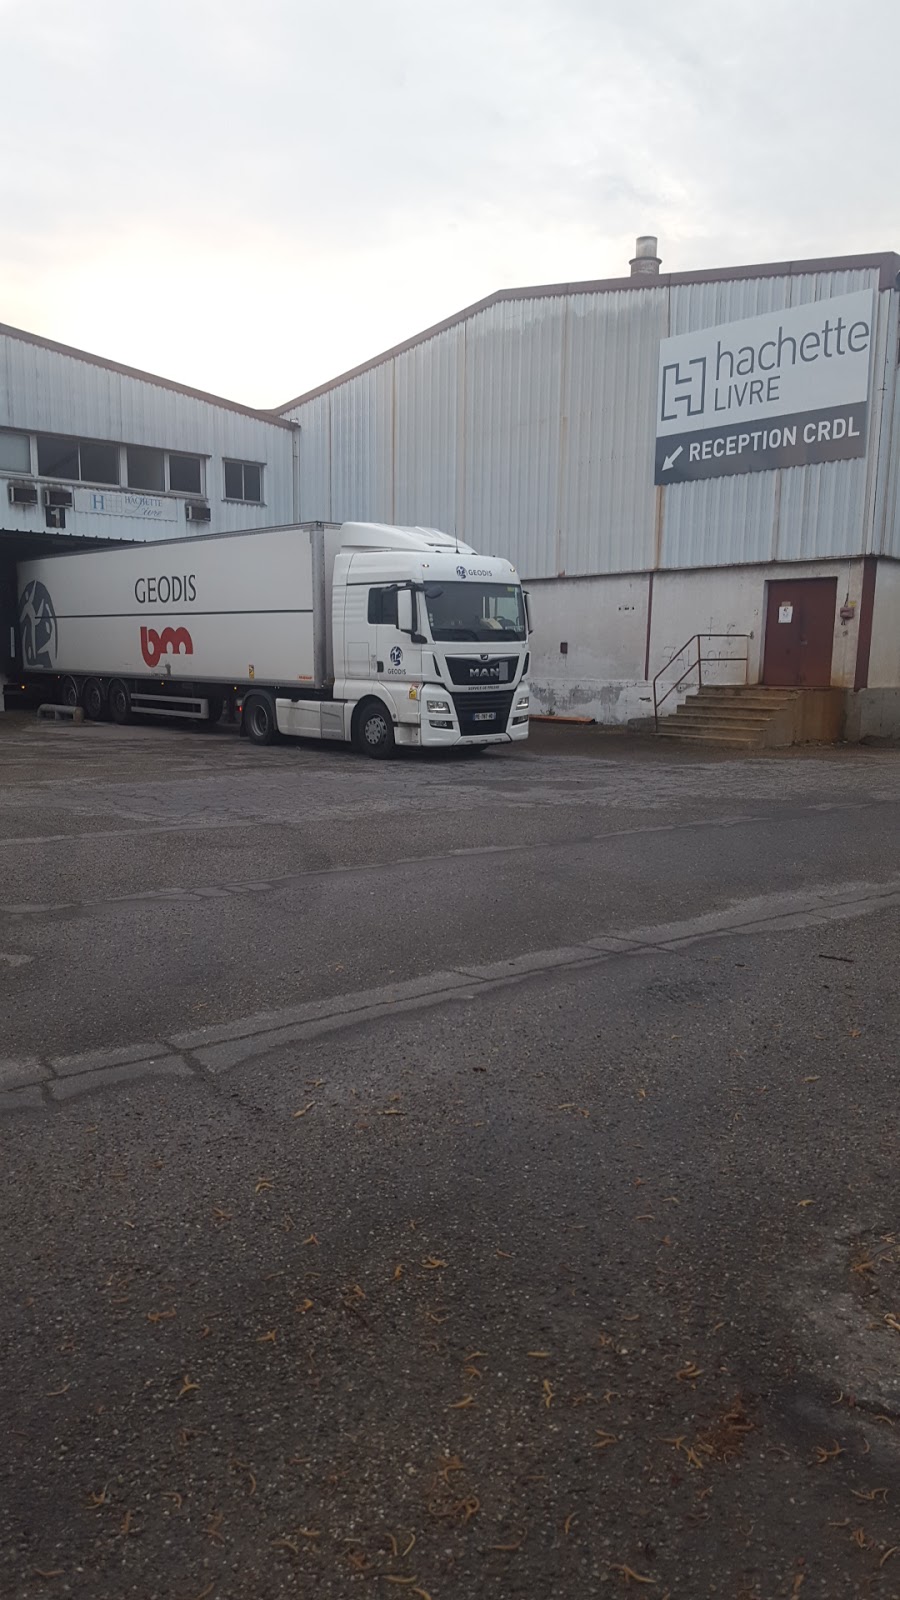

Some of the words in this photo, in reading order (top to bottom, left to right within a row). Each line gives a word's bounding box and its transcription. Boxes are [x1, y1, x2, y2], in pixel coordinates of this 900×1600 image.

[715, 317, 870, 381] hachette
[714, 375, 781, 412] LIVRE
[689, 425, 797, 462] RECEPTION
[803, 416, 860, 444] CRDL
[124, 495, 162, 507] HACHETTE
[50, 508, 61, 528] 1
[468, 569, 493, 577] GEODIS
[134, 574, 197, 604] GEODIS
[469, 668, 500, 677] MAN
